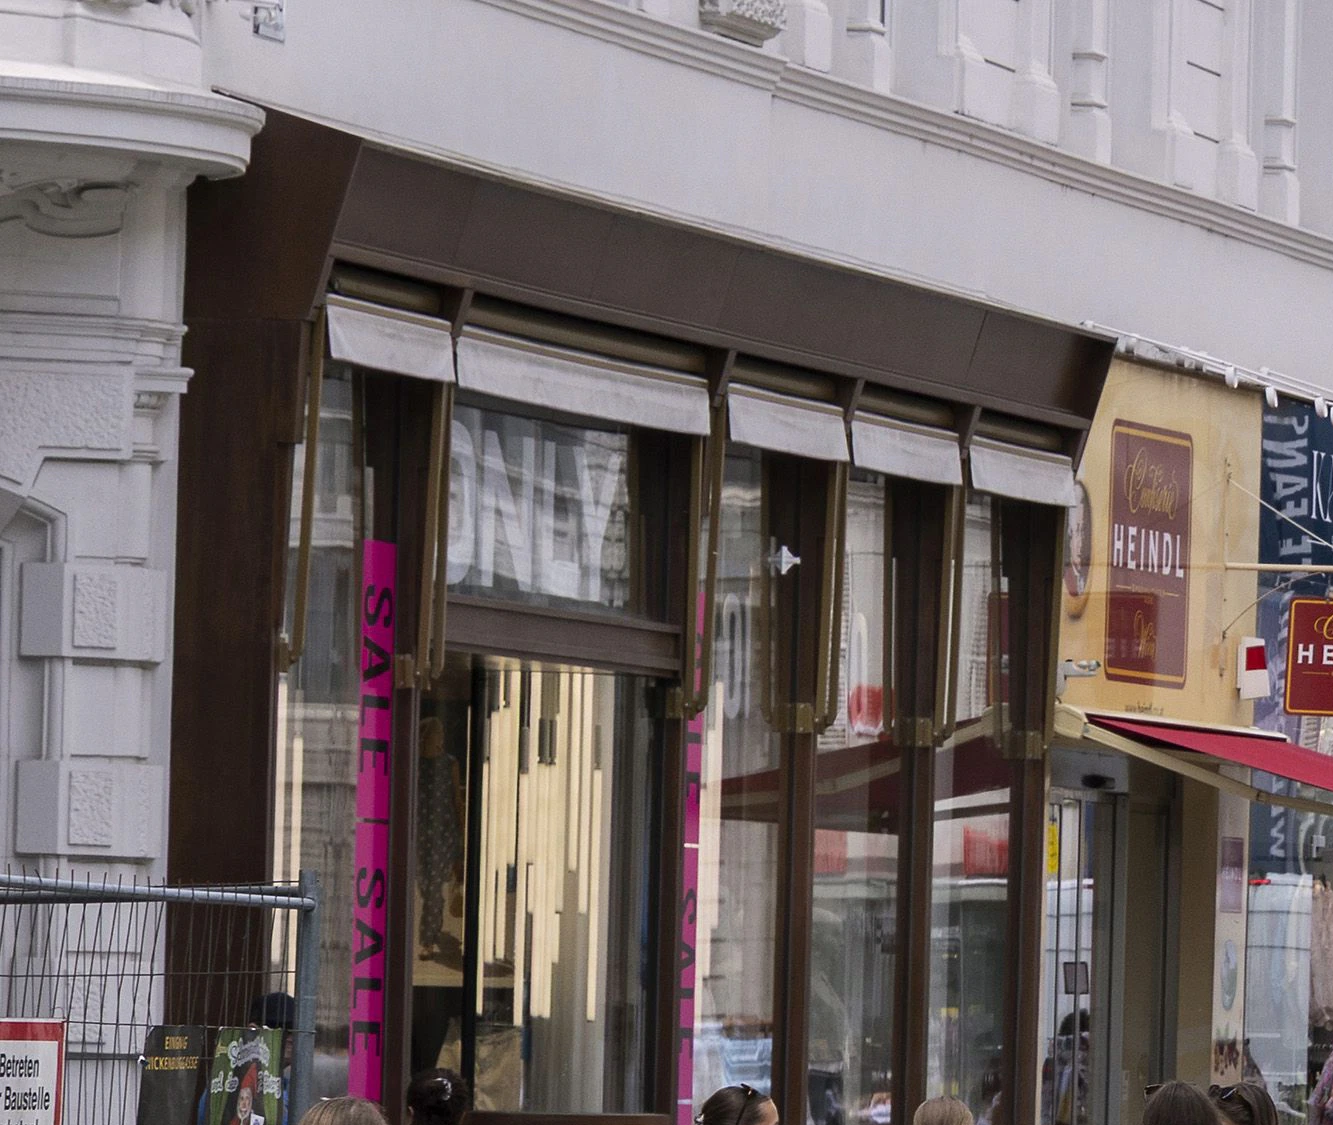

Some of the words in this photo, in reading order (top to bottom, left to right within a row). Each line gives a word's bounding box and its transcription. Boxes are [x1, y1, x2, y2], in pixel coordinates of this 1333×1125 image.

[446, 419, 622, 602] ONLY
[1113, 523, 1184, 578] HEINDL
[358, 583, 392, 776] SALE
[350, 867, 386, 1056] SALE
[0, 1053, 40, 1077] Betreten
[4, 1086, 50, 1111] Baustelle
